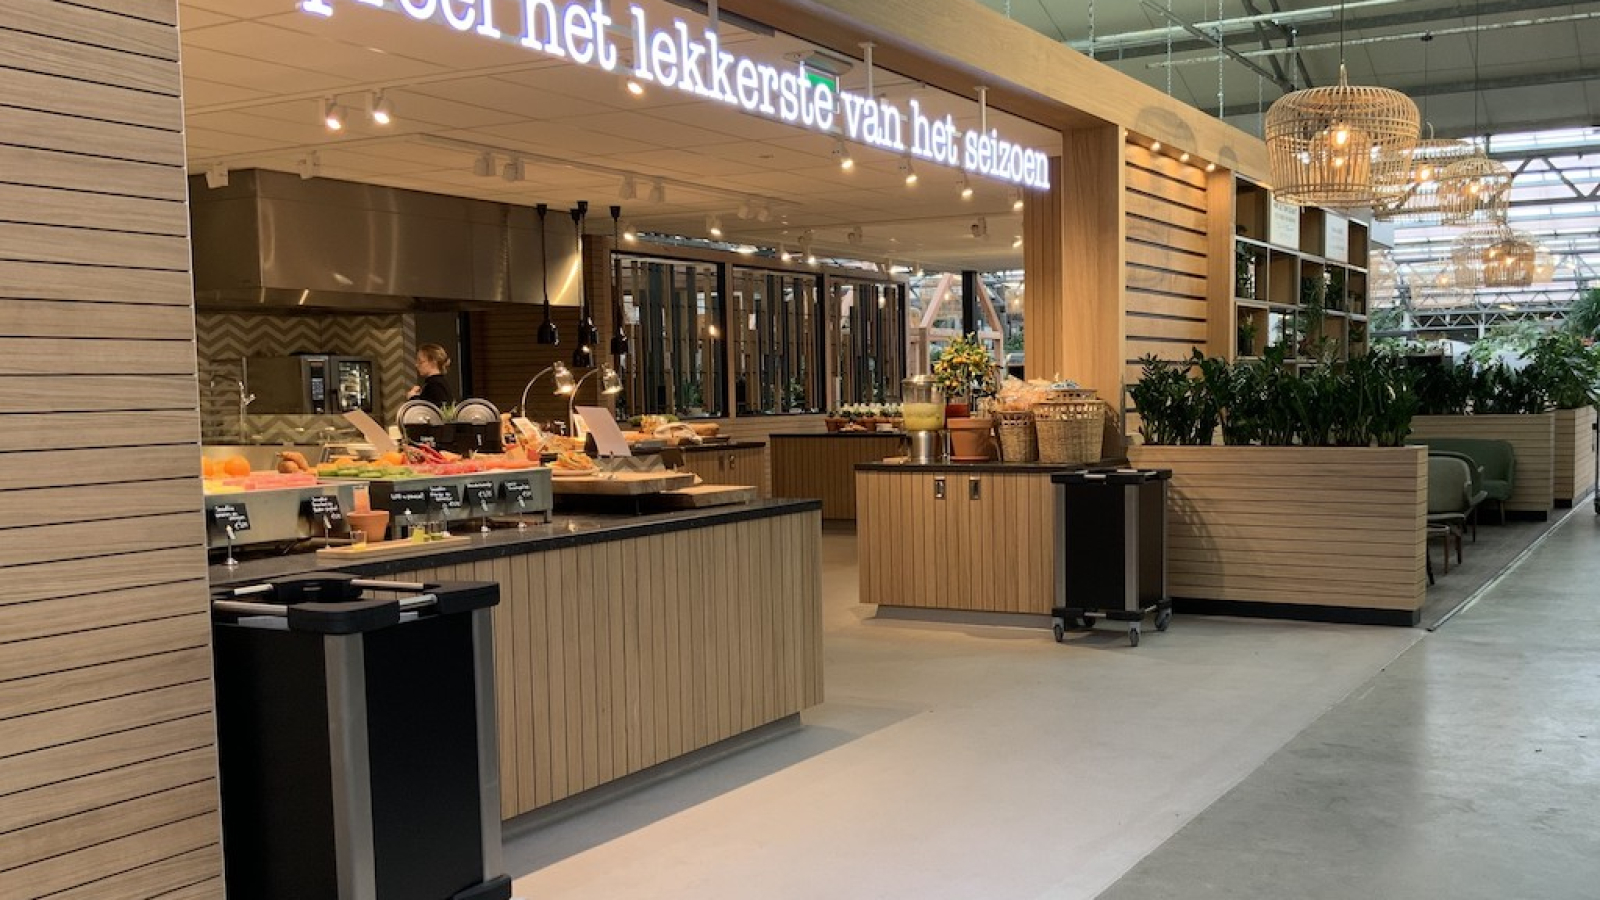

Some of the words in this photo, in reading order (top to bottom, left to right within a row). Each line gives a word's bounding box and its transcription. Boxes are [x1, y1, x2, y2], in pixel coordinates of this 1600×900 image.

[630, 5, 834, 131] lekkerste
[840, 91, 906, 151] van
[910, 99, 960, 165] het
[964, 129, 1051, 190] seizoen
